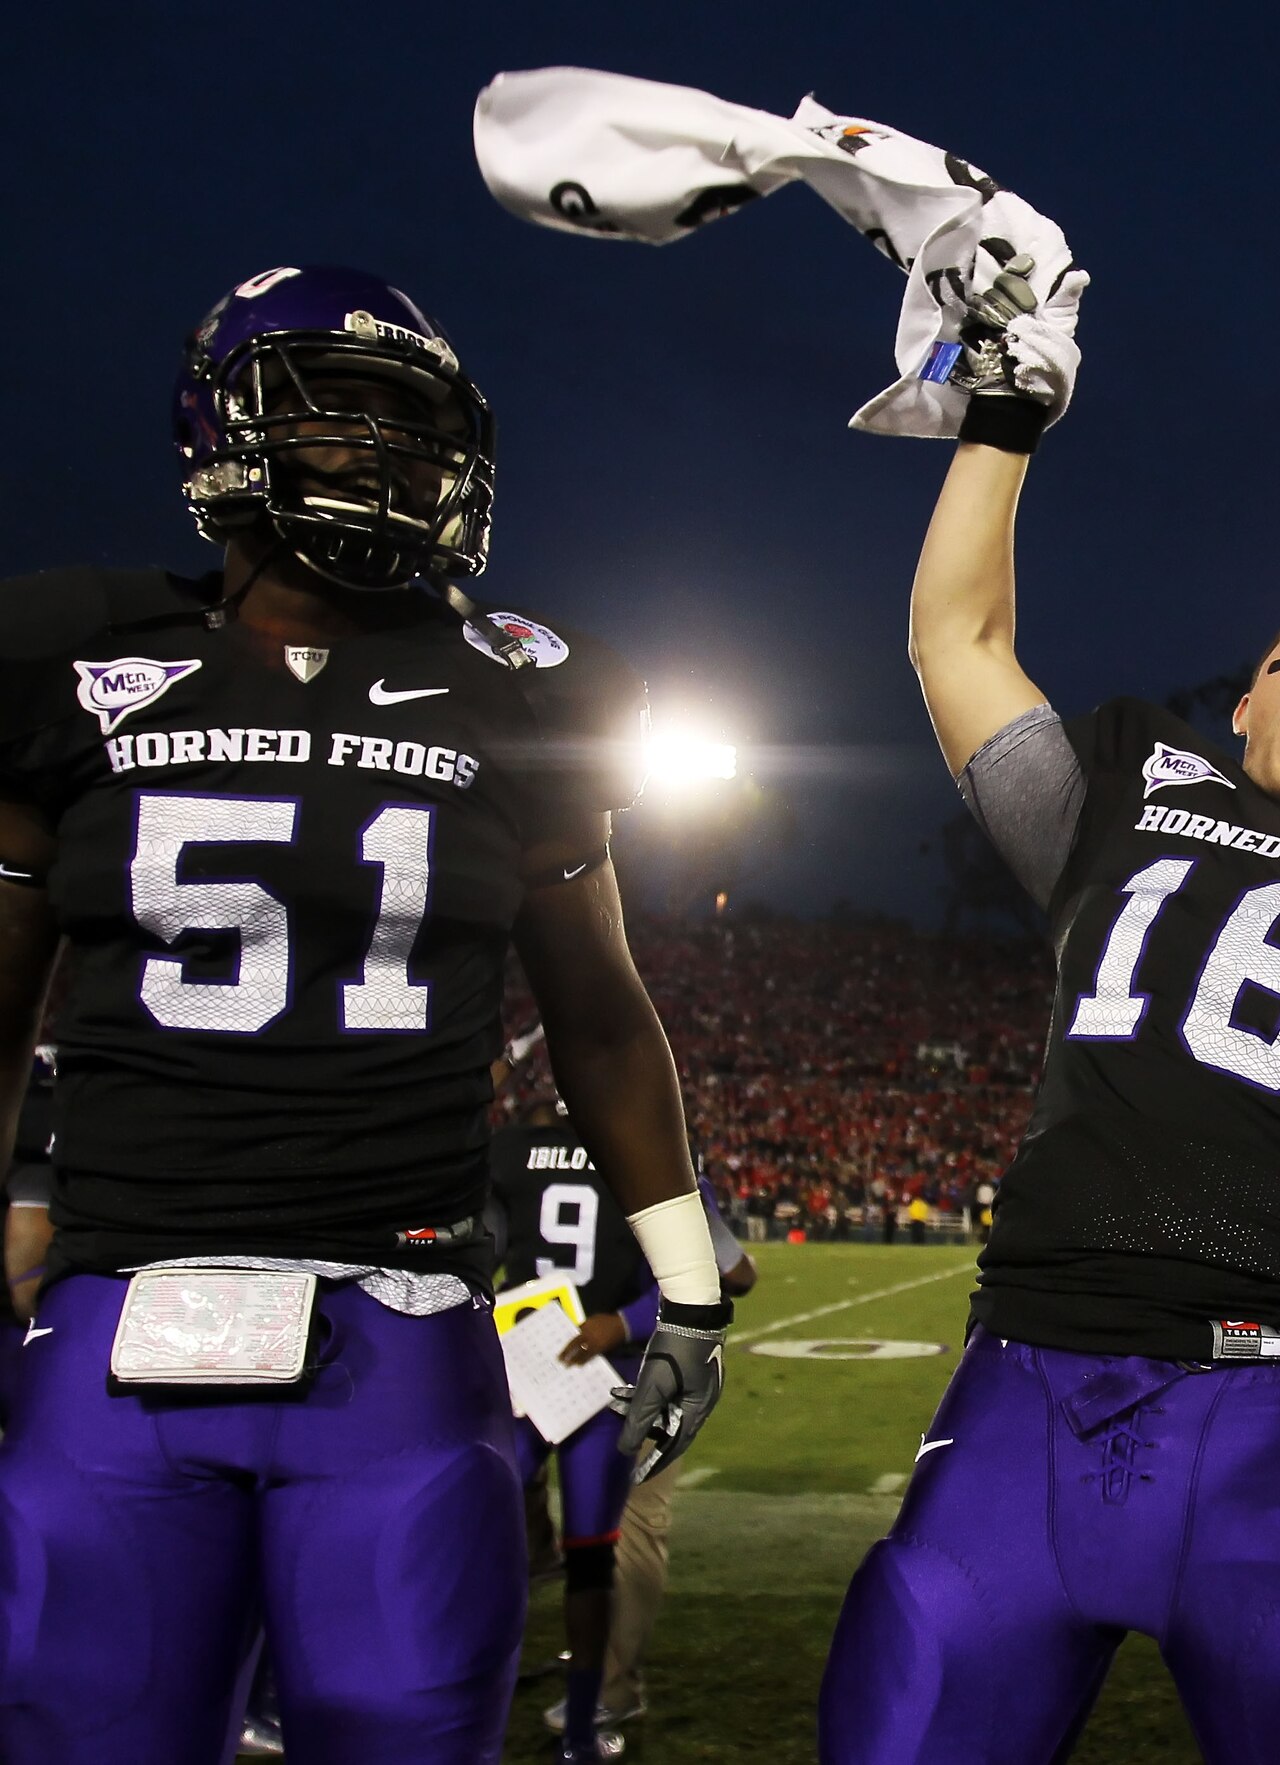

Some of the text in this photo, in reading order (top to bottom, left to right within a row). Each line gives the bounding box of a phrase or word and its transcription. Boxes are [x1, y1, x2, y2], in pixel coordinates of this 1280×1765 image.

[291, 651, 324, 663] TCU
[126, 681, 156, 694] WEST
[105, 728, 480, 790] HORNED FROGS
[1174, 768, 1198, 778] WEST
[130, 789, 437, 1035] 51
[535, 1183, 600, 1288] 9
[1226, 1329, 1258, 1337] TEAM
